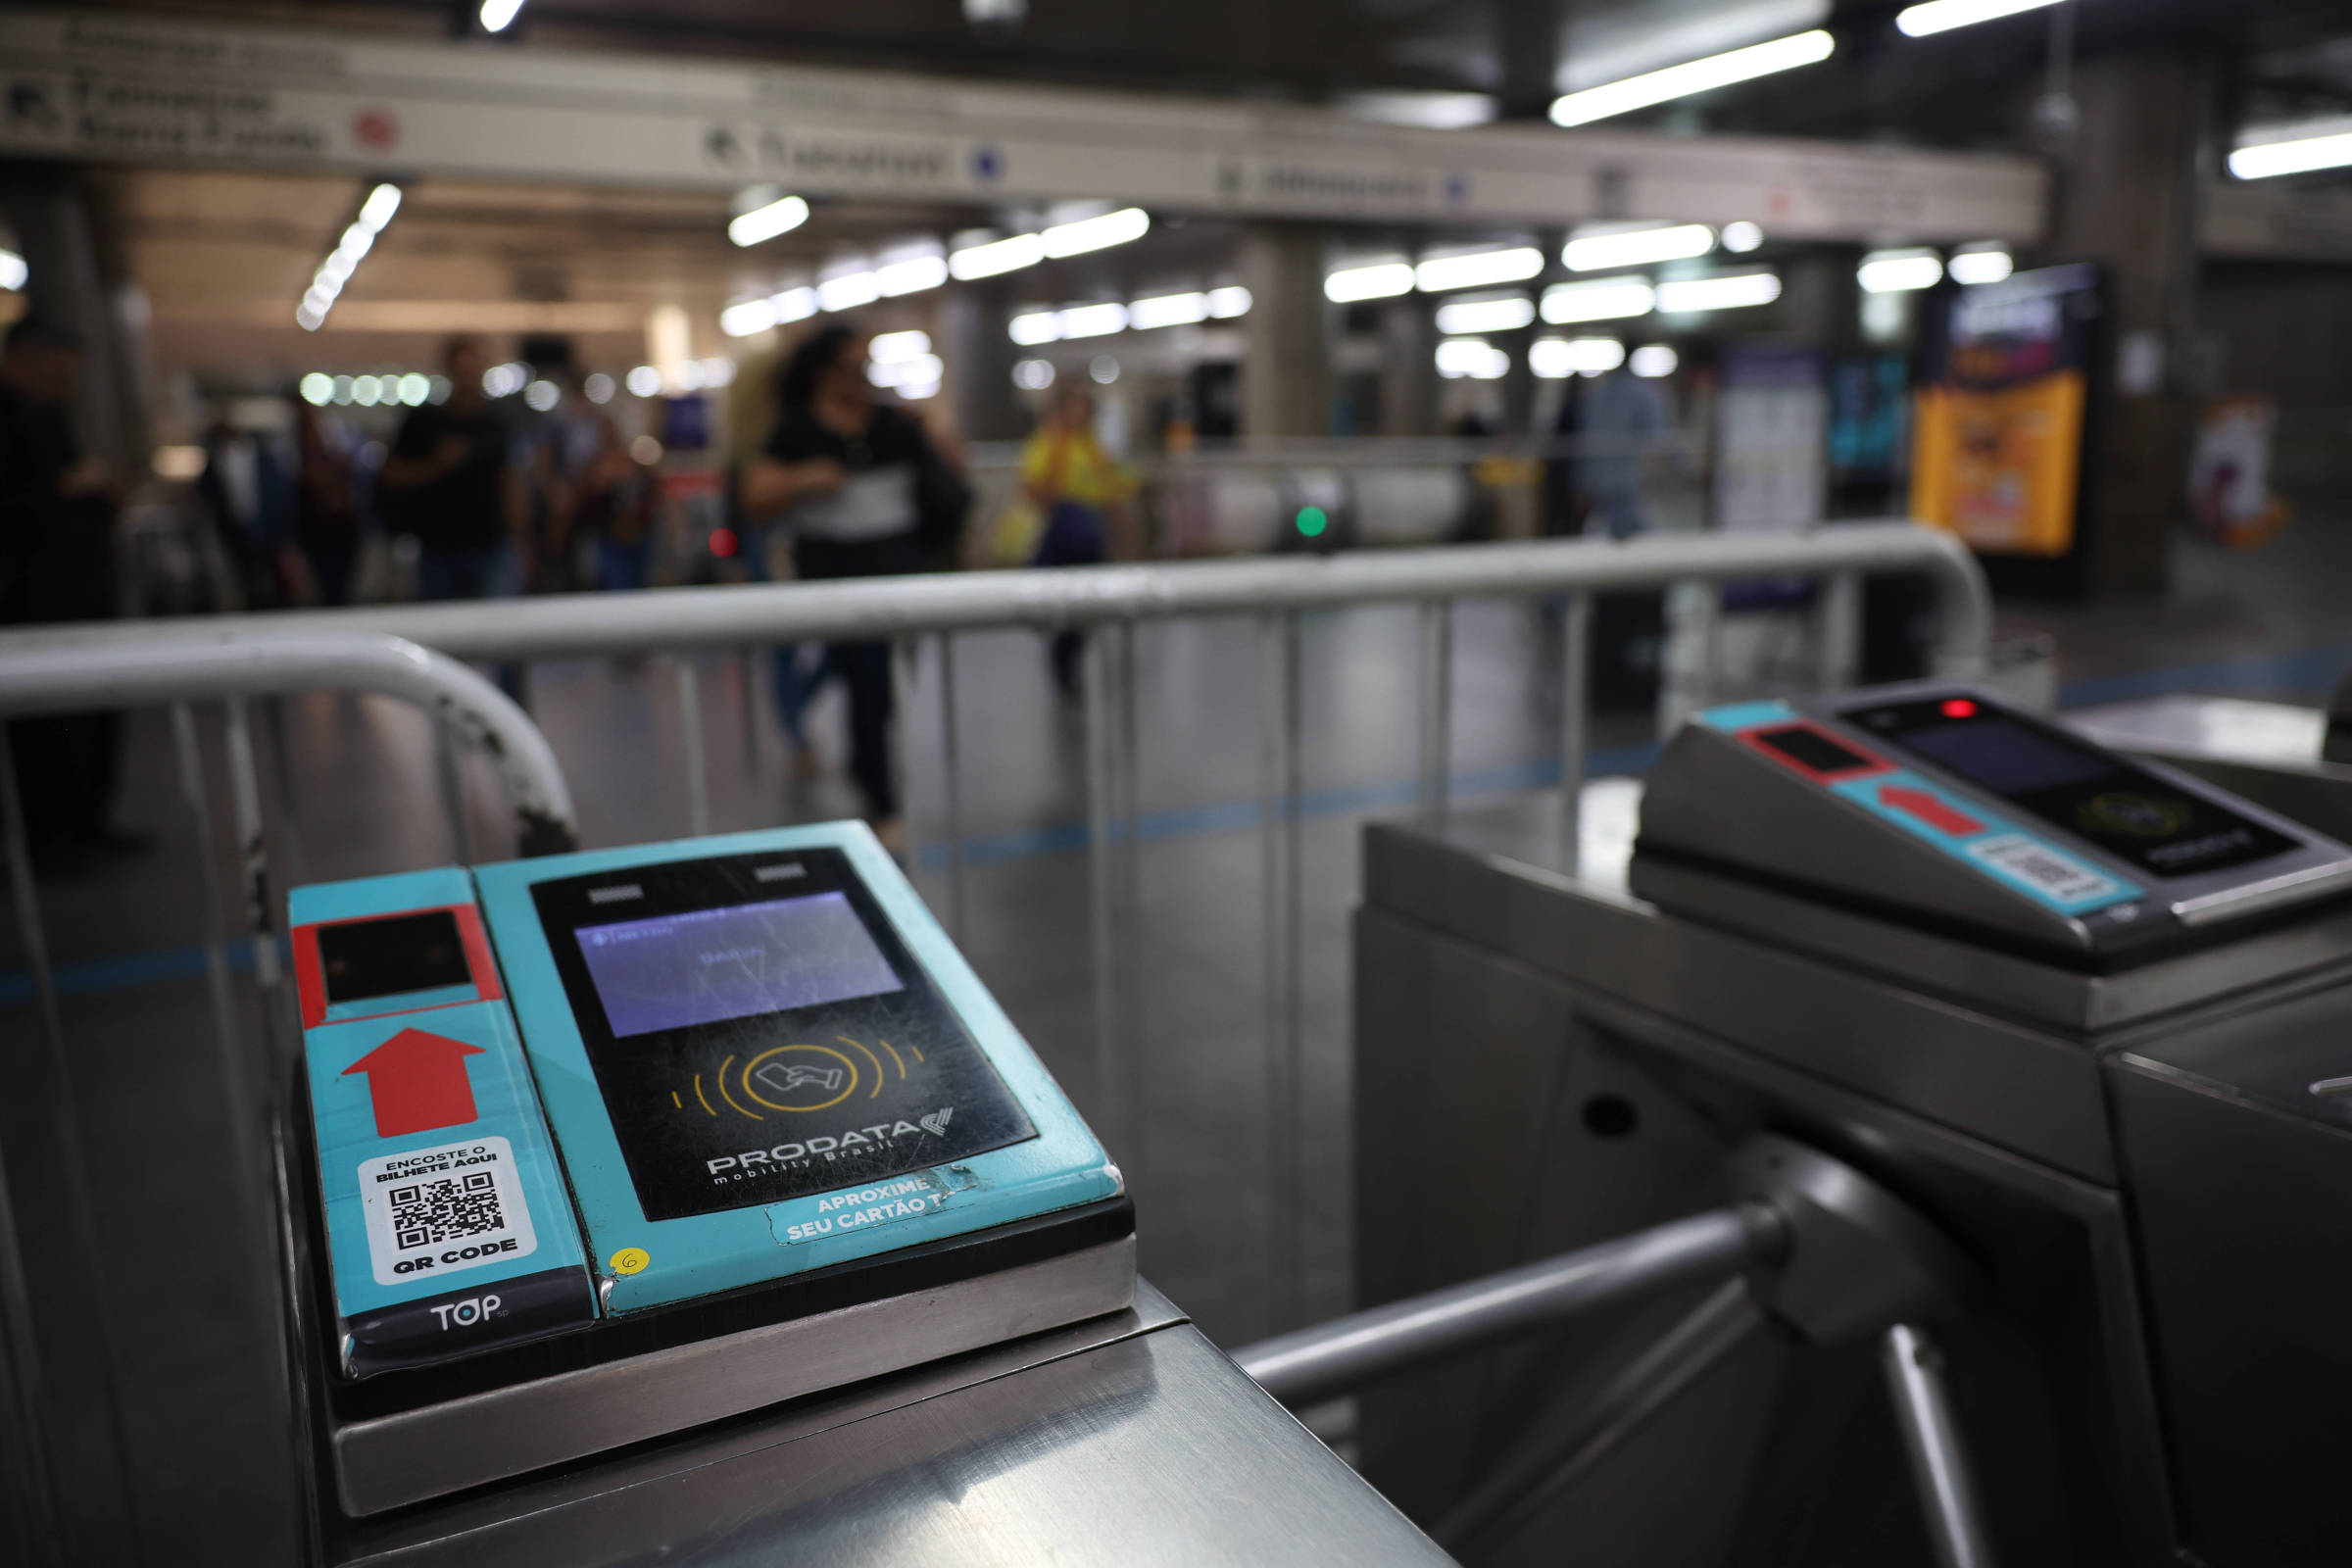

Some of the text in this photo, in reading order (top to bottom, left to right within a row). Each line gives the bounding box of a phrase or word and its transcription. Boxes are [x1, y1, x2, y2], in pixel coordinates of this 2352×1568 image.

[386, 1146, 486, 1170] ENCOSTE O
[706, 1119, 921, 1175] PRODATA
[713, 1139, 895, 1185] mobility Brasil
[376, 1152, 499, 1183] BILHETE AQUI
[817, 1176, 931, 1214] APROXIME
[786, 1217, 833, 1241] SEU
[837, 1198, 926, 1228] CARTÃO
[393, 1238, 518, 1275] QR CODE
[621, 1252, 638, 1268] 6
[429, 1294, 502, 1332] TOP
